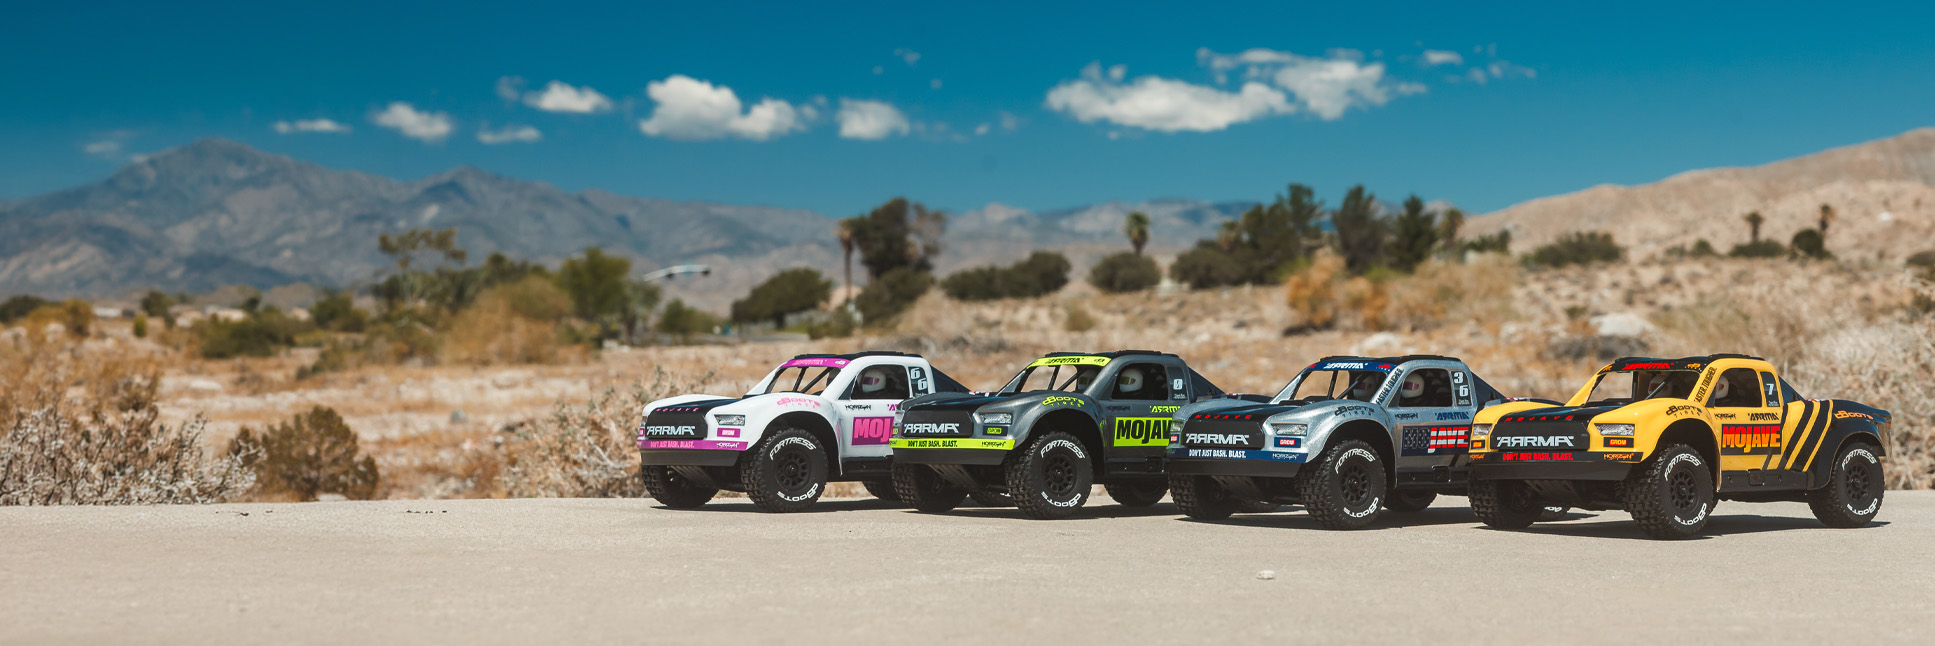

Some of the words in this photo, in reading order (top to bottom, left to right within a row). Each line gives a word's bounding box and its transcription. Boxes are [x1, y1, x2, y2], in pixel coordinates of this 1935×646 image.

[1766, 383, 1775, 396] 7
[1149, 405, 1181, 413] ARRM
[853, 418, 891, 443] MOJ
[1115, 419, 1172, 444] MOJAV
[1722, 425, 1781, 453] MOJAVE
[769, 436, 817, 460] FORTRESS
[1040, 440, 1086, 459] FORTRESS
[1519, 452, 1532, 461] JUST
[1533, 452, 1551, 461] BASH.
[1552, 452, 1574, 461] BLAST.
[1841, 448, 1878, 471] FORTRESS
[1334, 448, 1376, 474] FORTRESS
[1664, 453, 1702, 481] FORTRESS
